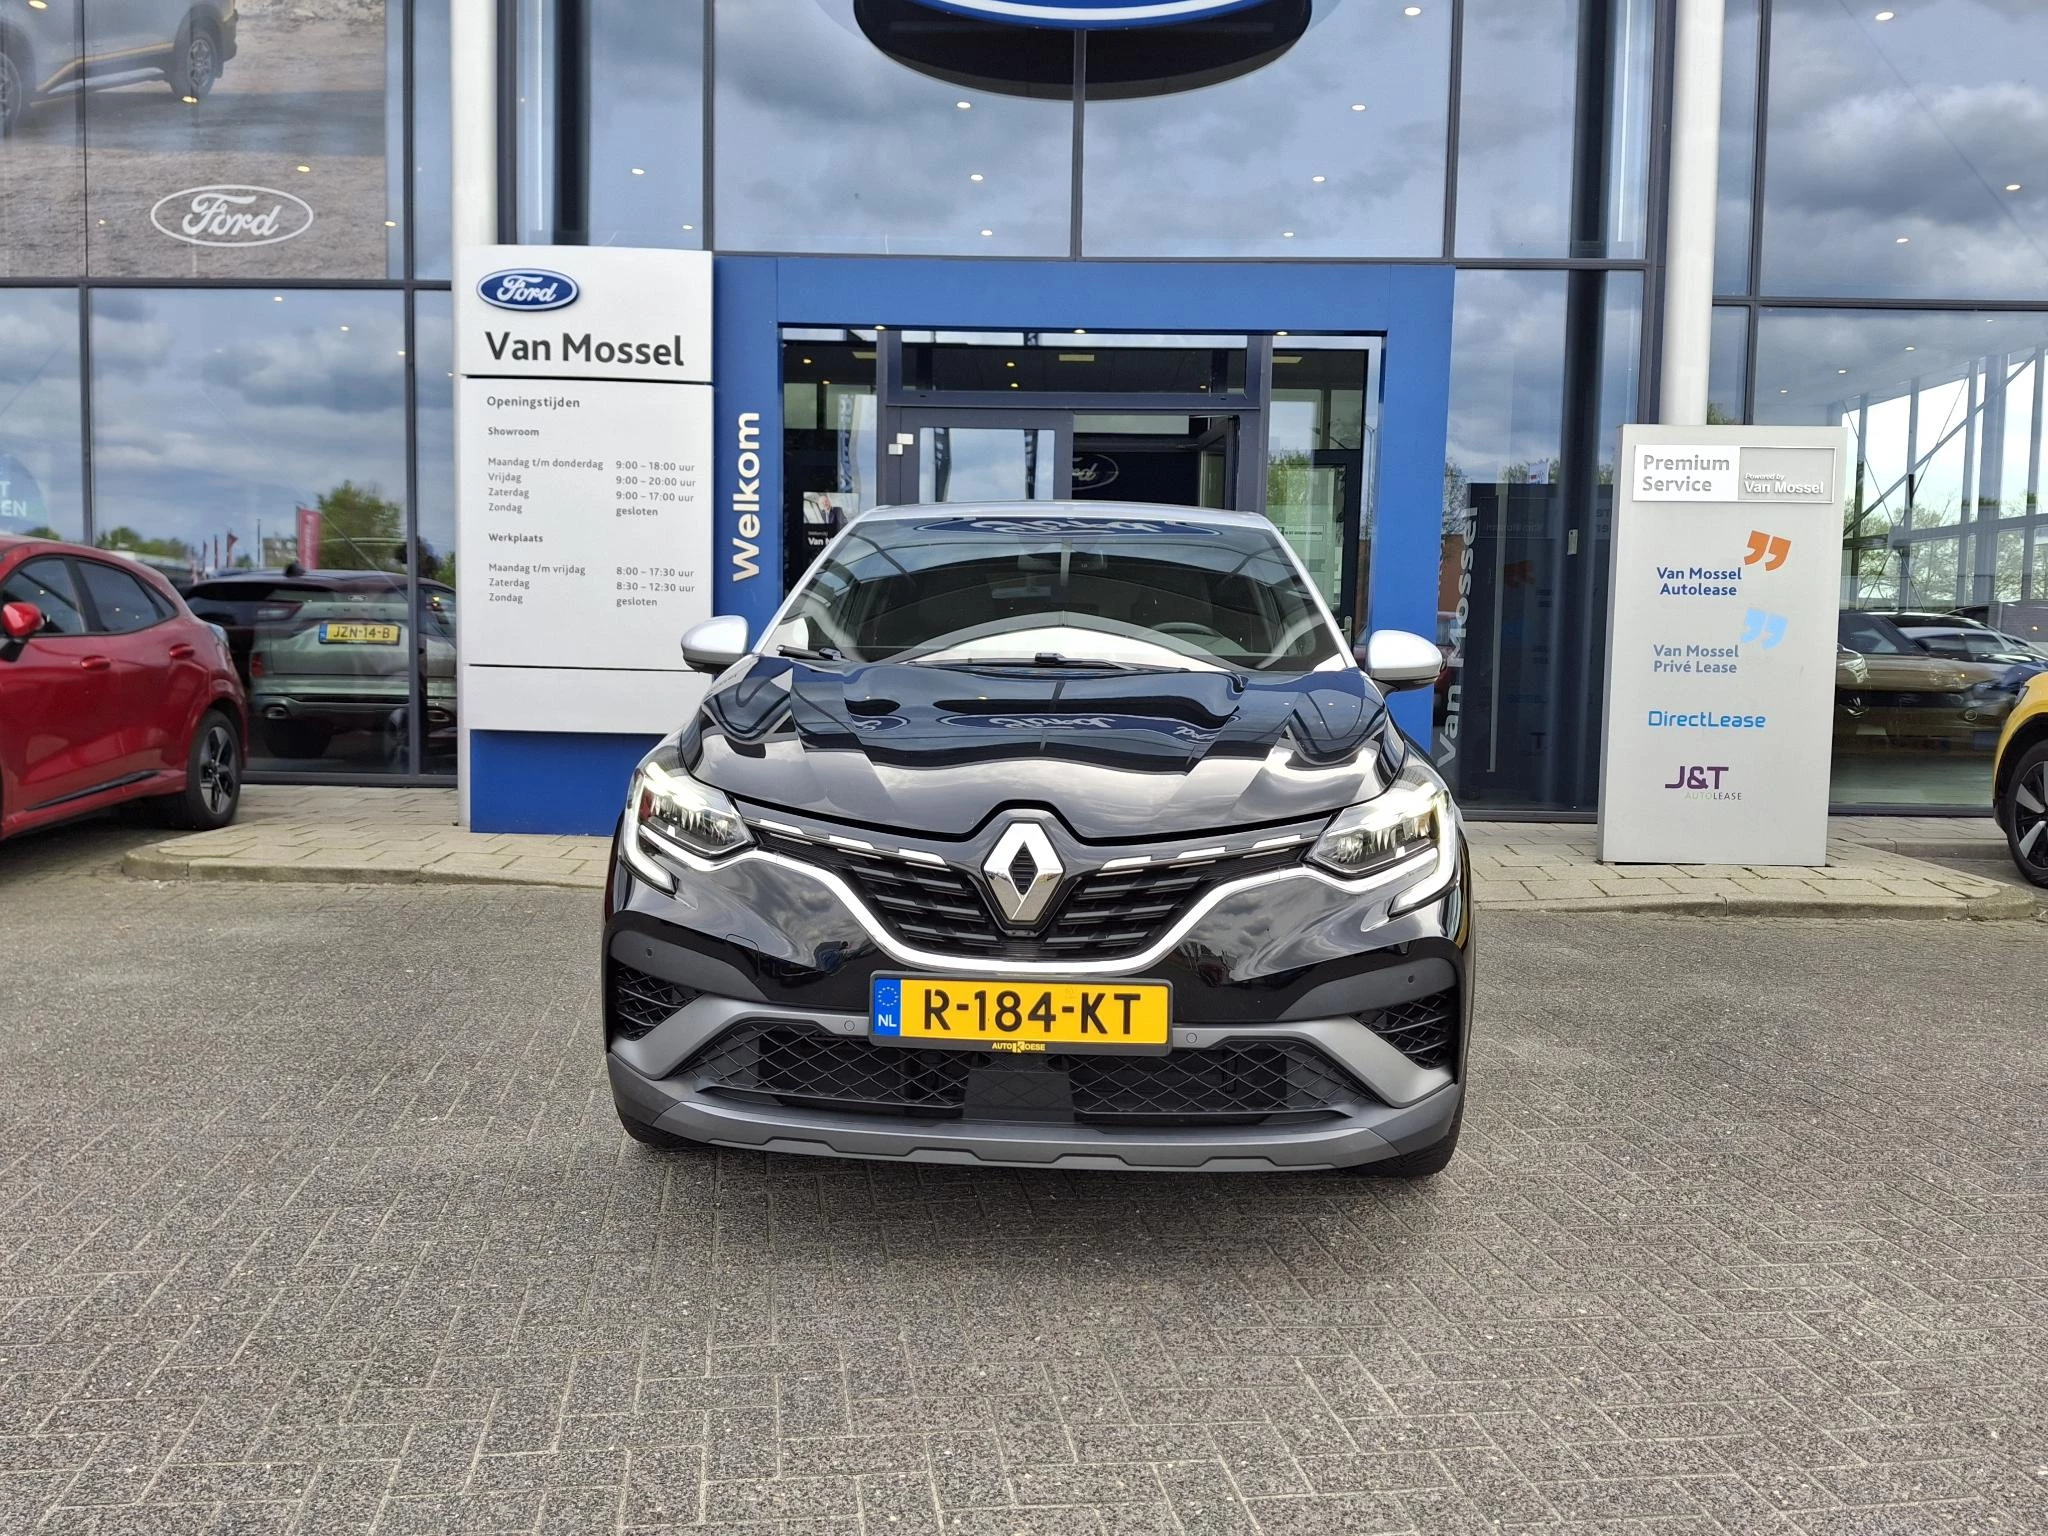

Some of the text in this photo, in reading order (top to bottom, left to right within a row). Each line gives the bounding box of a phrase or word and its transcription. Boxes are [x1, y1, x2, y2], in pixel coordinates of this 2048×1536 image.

[182, 193, 282, 236] Ford
[496, 274, 559, 303] Ford
[485, 332, 684, 366] Van Mossel
[487, 396, 579, 410] Openingstijden
[488, 427, 539, 436] Showroom
[488, 458, 529, 468] Maandag
[532, 458, 549, 466] t/m
[552, 458, 603, 470] donderdag
[616, 461, 638, 470] 9:00
[649, 462, 676, 471] 18:00
[679, 464, 695, 472] uur
[1644, 455, 1729, 470] Premium
[488, 473, 521, 484] Vrijdag
[616, 476, 638, 485] 9:00
[649, 477, 676, 487] 20:00
[680, 479, 697, 487] uur
[1643, 476, 1711, 491] Service
[1744, 481, 1824, 494] Van Mossel
[489, 488, 529, 499] Zaterdag
[616, 491, 638, 500] 9:00
[649, 492, 675, 502] 17:00
[679, 495, 694, 503] uur
[733, 413, 760, 581] Welkom
[489, 503, 658, 517] Zondag gesloten
[489, 533, 543, 544] Werkplaats
[489, 564, 530, 574] Maandag
[533, 564, 550, 572] t/m
[553, 565, 585, 576] vrijdag
[617, 567, 638, 576] 8:00
[650, 568, 675, 577] 17:30
[679, 570, 694, 578] uur
[1657, 567, 1741, 579] Van Mossel
[489, 578, 529, 589] Zaterdag
[617, 582, 638, 591] 8:30
[650, 583, 676, 592] 12:30
[680, 585, 695, 593] uur
[1660, 583, 1737, 595] Autolease
[489, 593, 657, 607] Zondag gesloten
[333, 626, 391, 639] JZN-14-B
[1437, 507, 1478, 769] Van Mossel
[1654, 644, 1739, 657] Van Mossel
[1654, 660, 1737, 673] Privé Lease
[1649, 711, 1766, 727] DirectLease
[1665, 766, 1729, 789] J&T
[1685, 792, 1742, 800] AUTOLEASE
[924, 989, 1141, 1034] R-184-KT
[878, 1014, 897, 1027] NL
